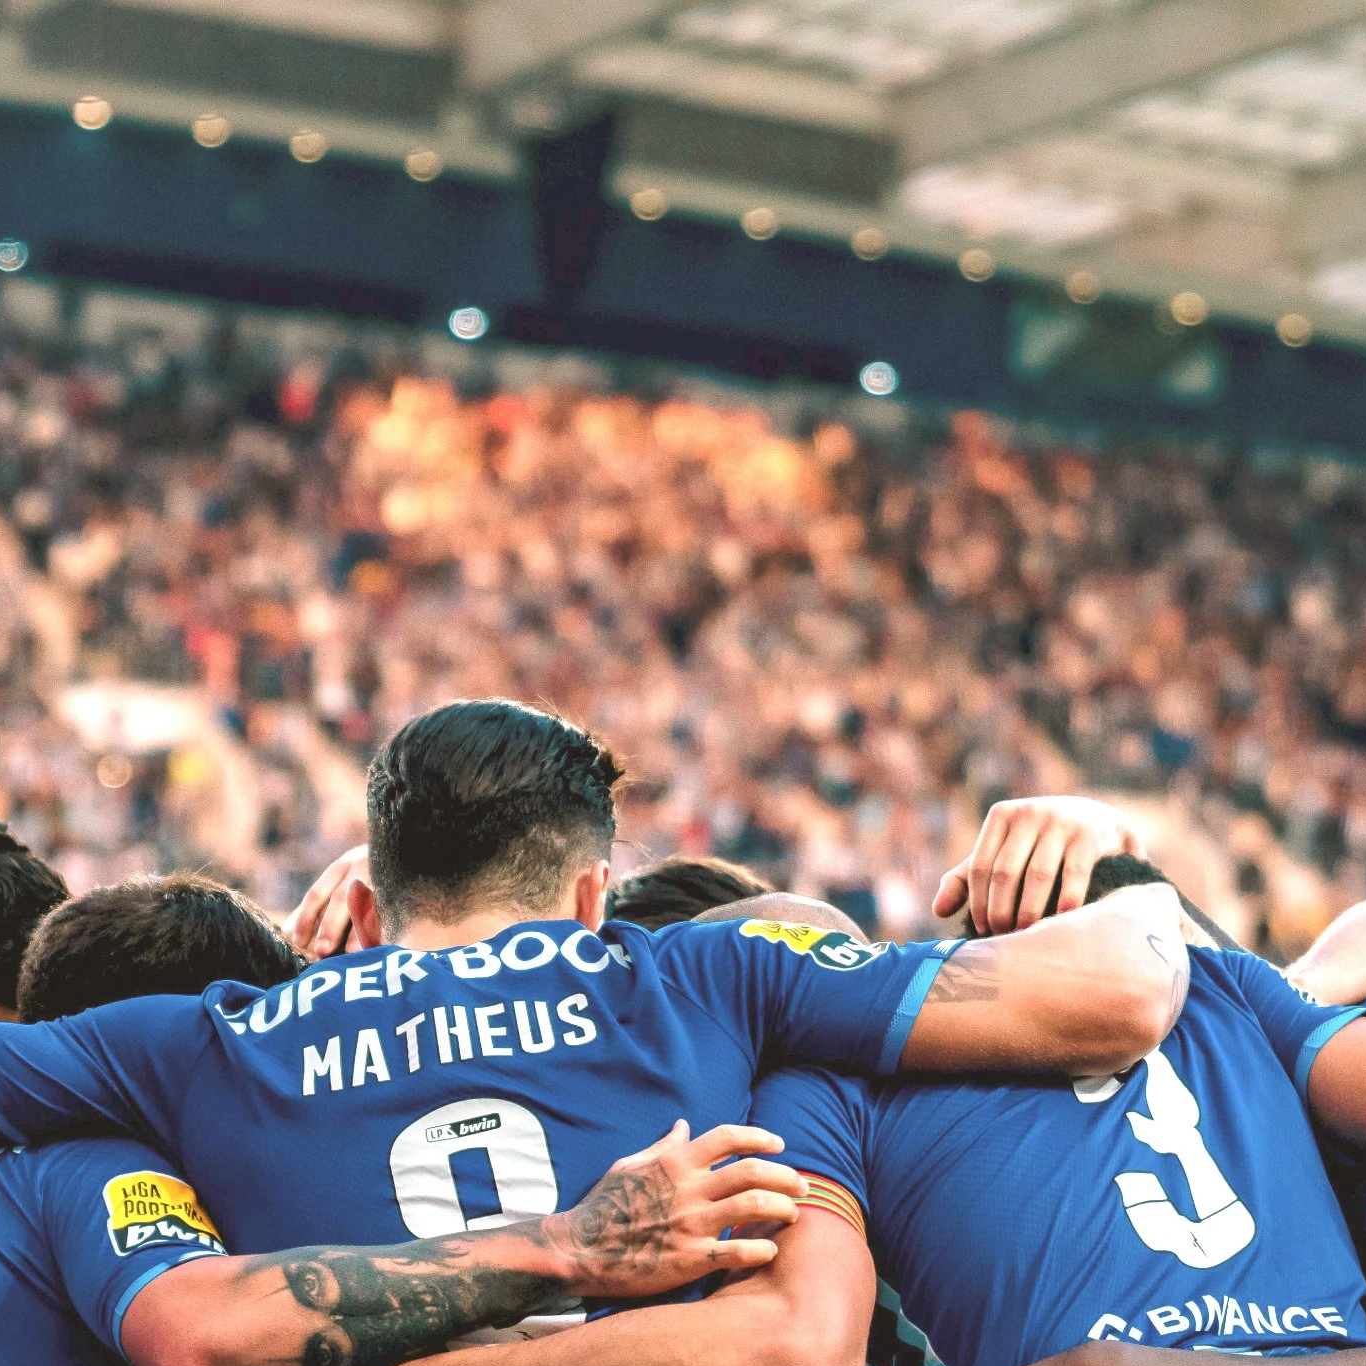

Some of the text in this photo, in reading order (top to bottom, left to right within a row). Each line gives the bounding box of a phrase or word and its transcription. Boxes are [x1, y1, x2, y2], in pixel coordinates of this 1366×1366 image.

[302, 993, 598, 1096] MATHEUS
[459, 1117, 497, 1136] bwin
[1073, 1044, 1256, 1269] 3
[122, 1181, 162, 1199] LIGA
[1146, 1294, 1348, 1337] BINANCE
